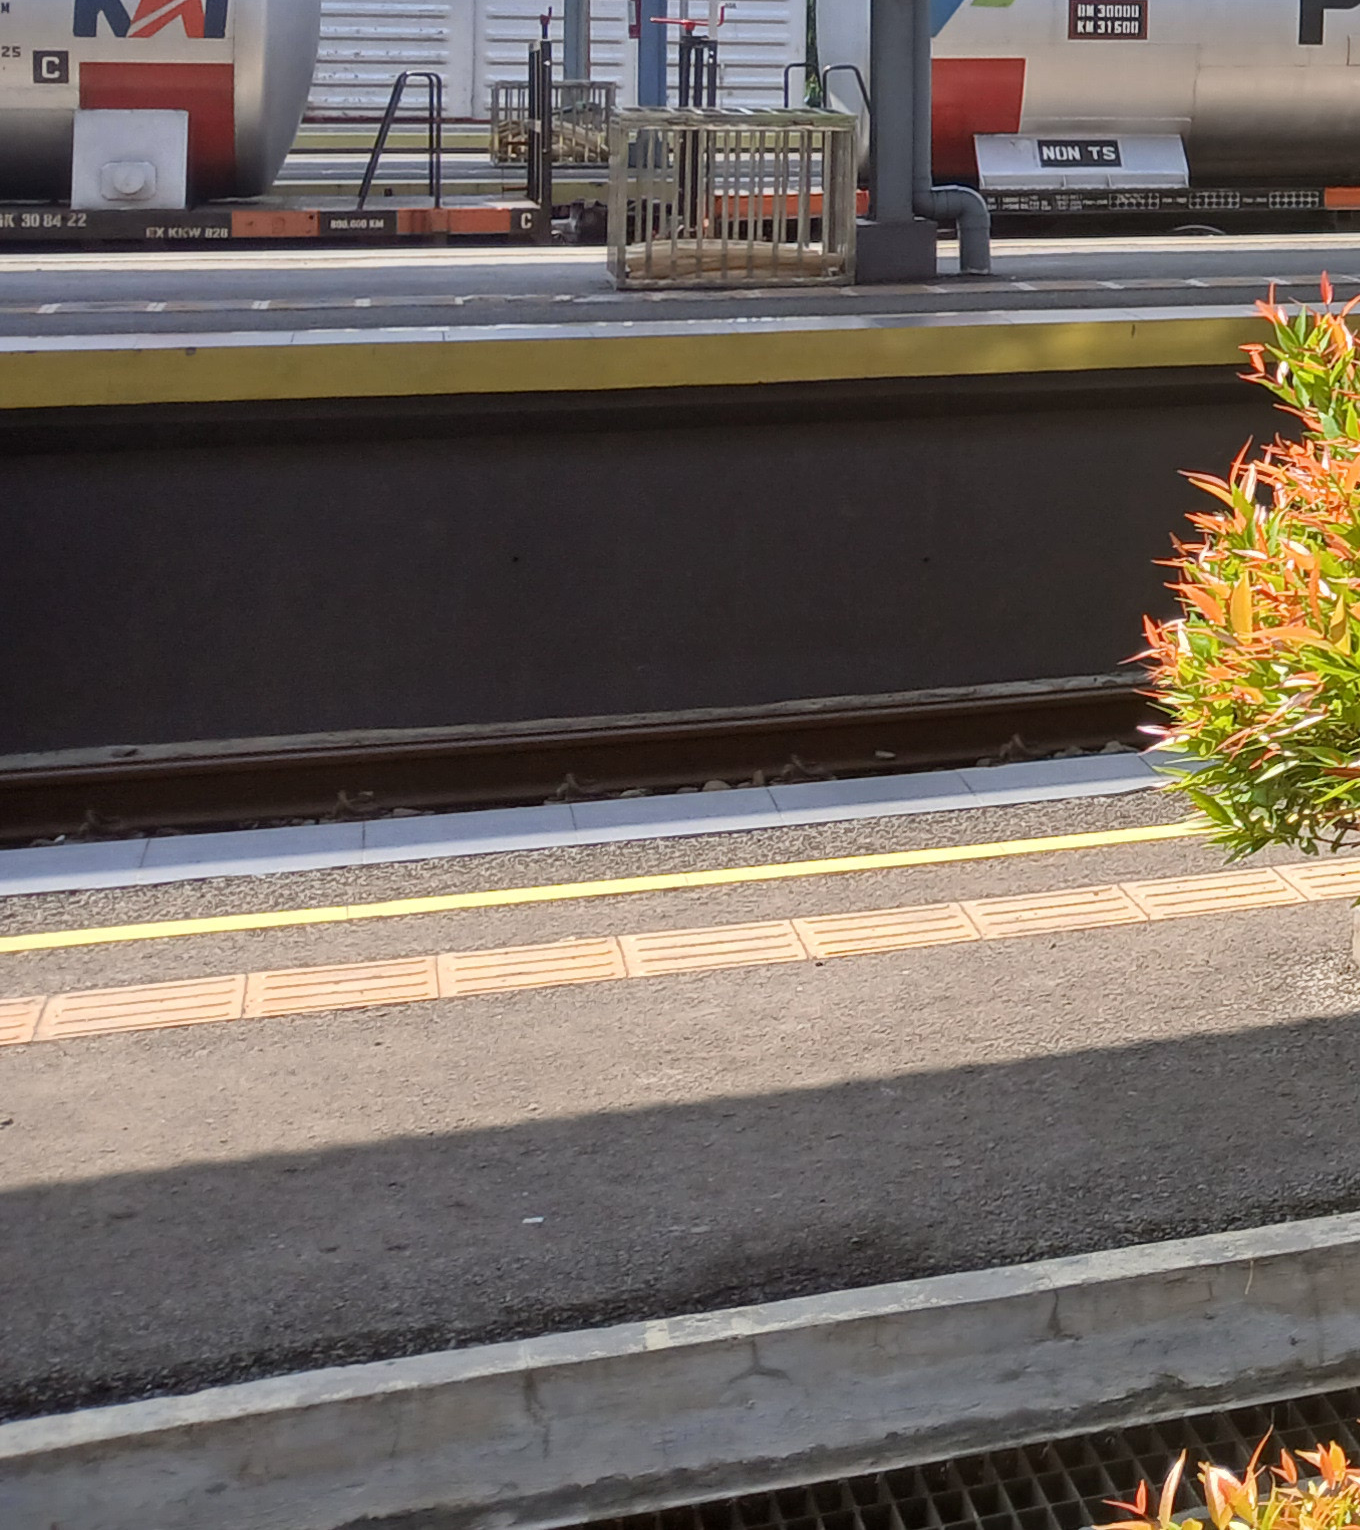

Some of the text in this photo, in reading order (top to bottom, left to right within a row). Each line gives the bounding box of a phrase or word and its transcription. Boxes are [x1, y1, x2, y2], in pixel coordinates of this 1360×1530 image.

[1097, 4, 1140, 18] 30000
[41, 56, 60, 79] C
[1042, 146, 1117, 161] NON TS
[21, 213, 40, 228] 30
[43, 213, 62, 228] 84
[67, 212, 87, 227] 22
[520, 213, 533, 229] C
[168, 227, 201, 239] KKW
